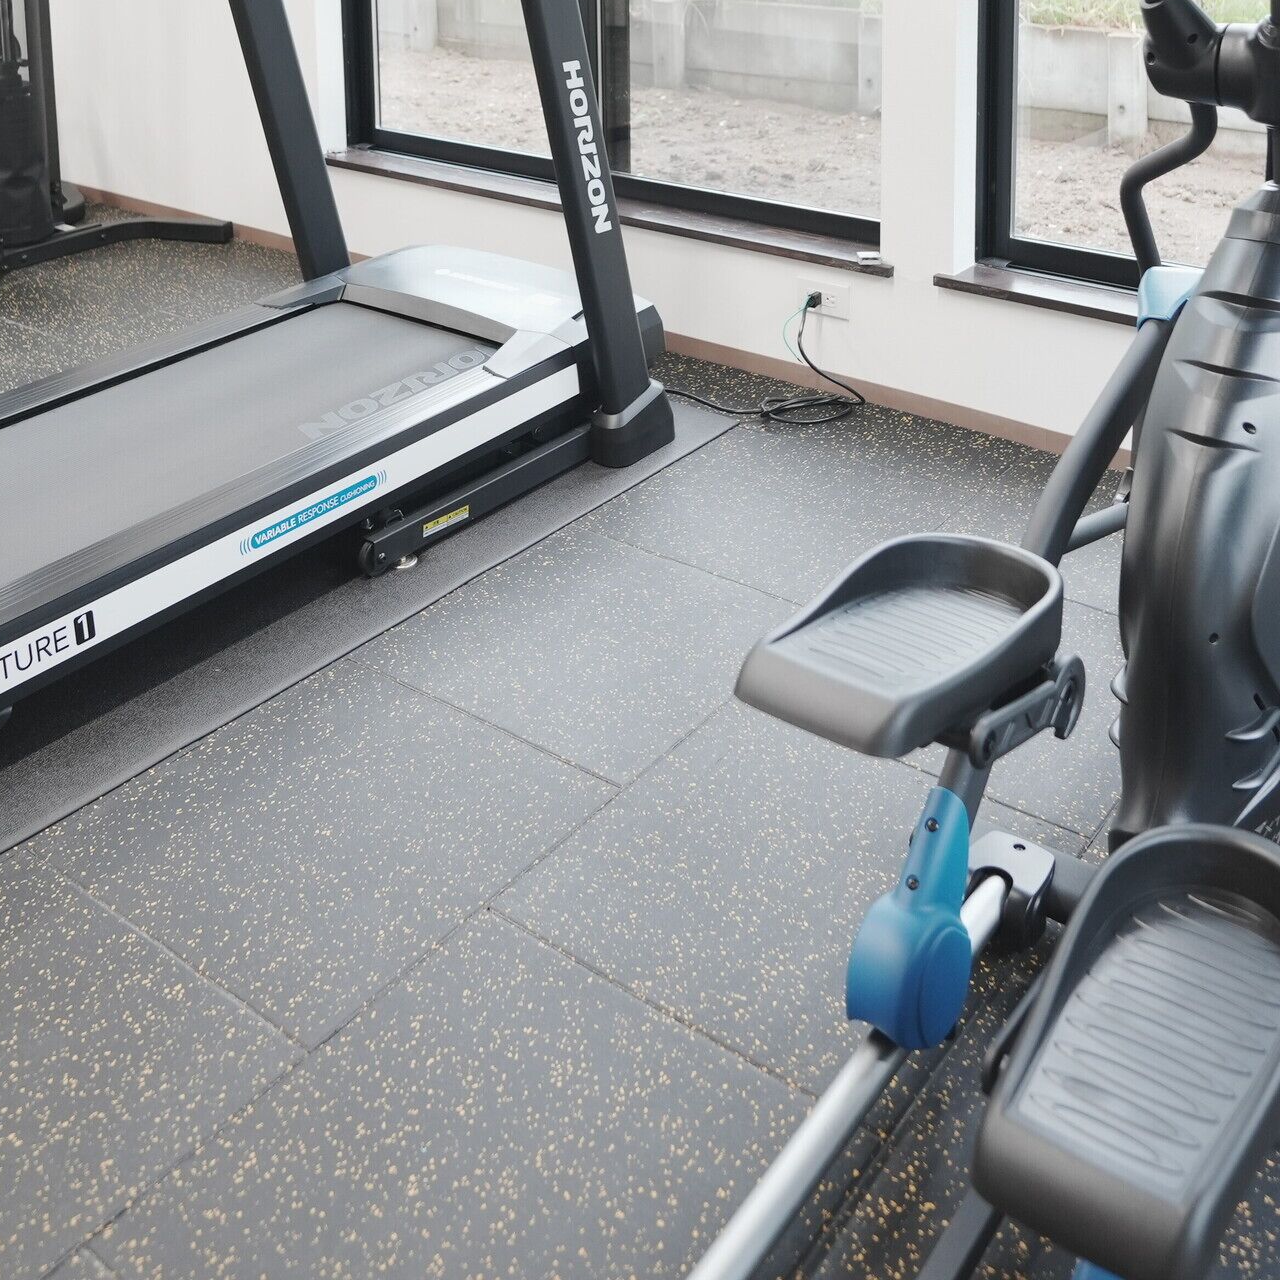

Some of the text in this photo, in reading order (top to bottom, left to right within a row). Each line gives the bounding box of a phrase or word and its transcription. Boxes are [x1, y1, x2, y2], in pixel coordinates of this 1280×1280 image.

[562, 60, 612, 234] HORIZON
[297, 344, 499, 440] ORIZON
[254, 480, 376, 546] VARIABLE RESPONSE CUSHIONING
[74, 611, 94, 644] 1
